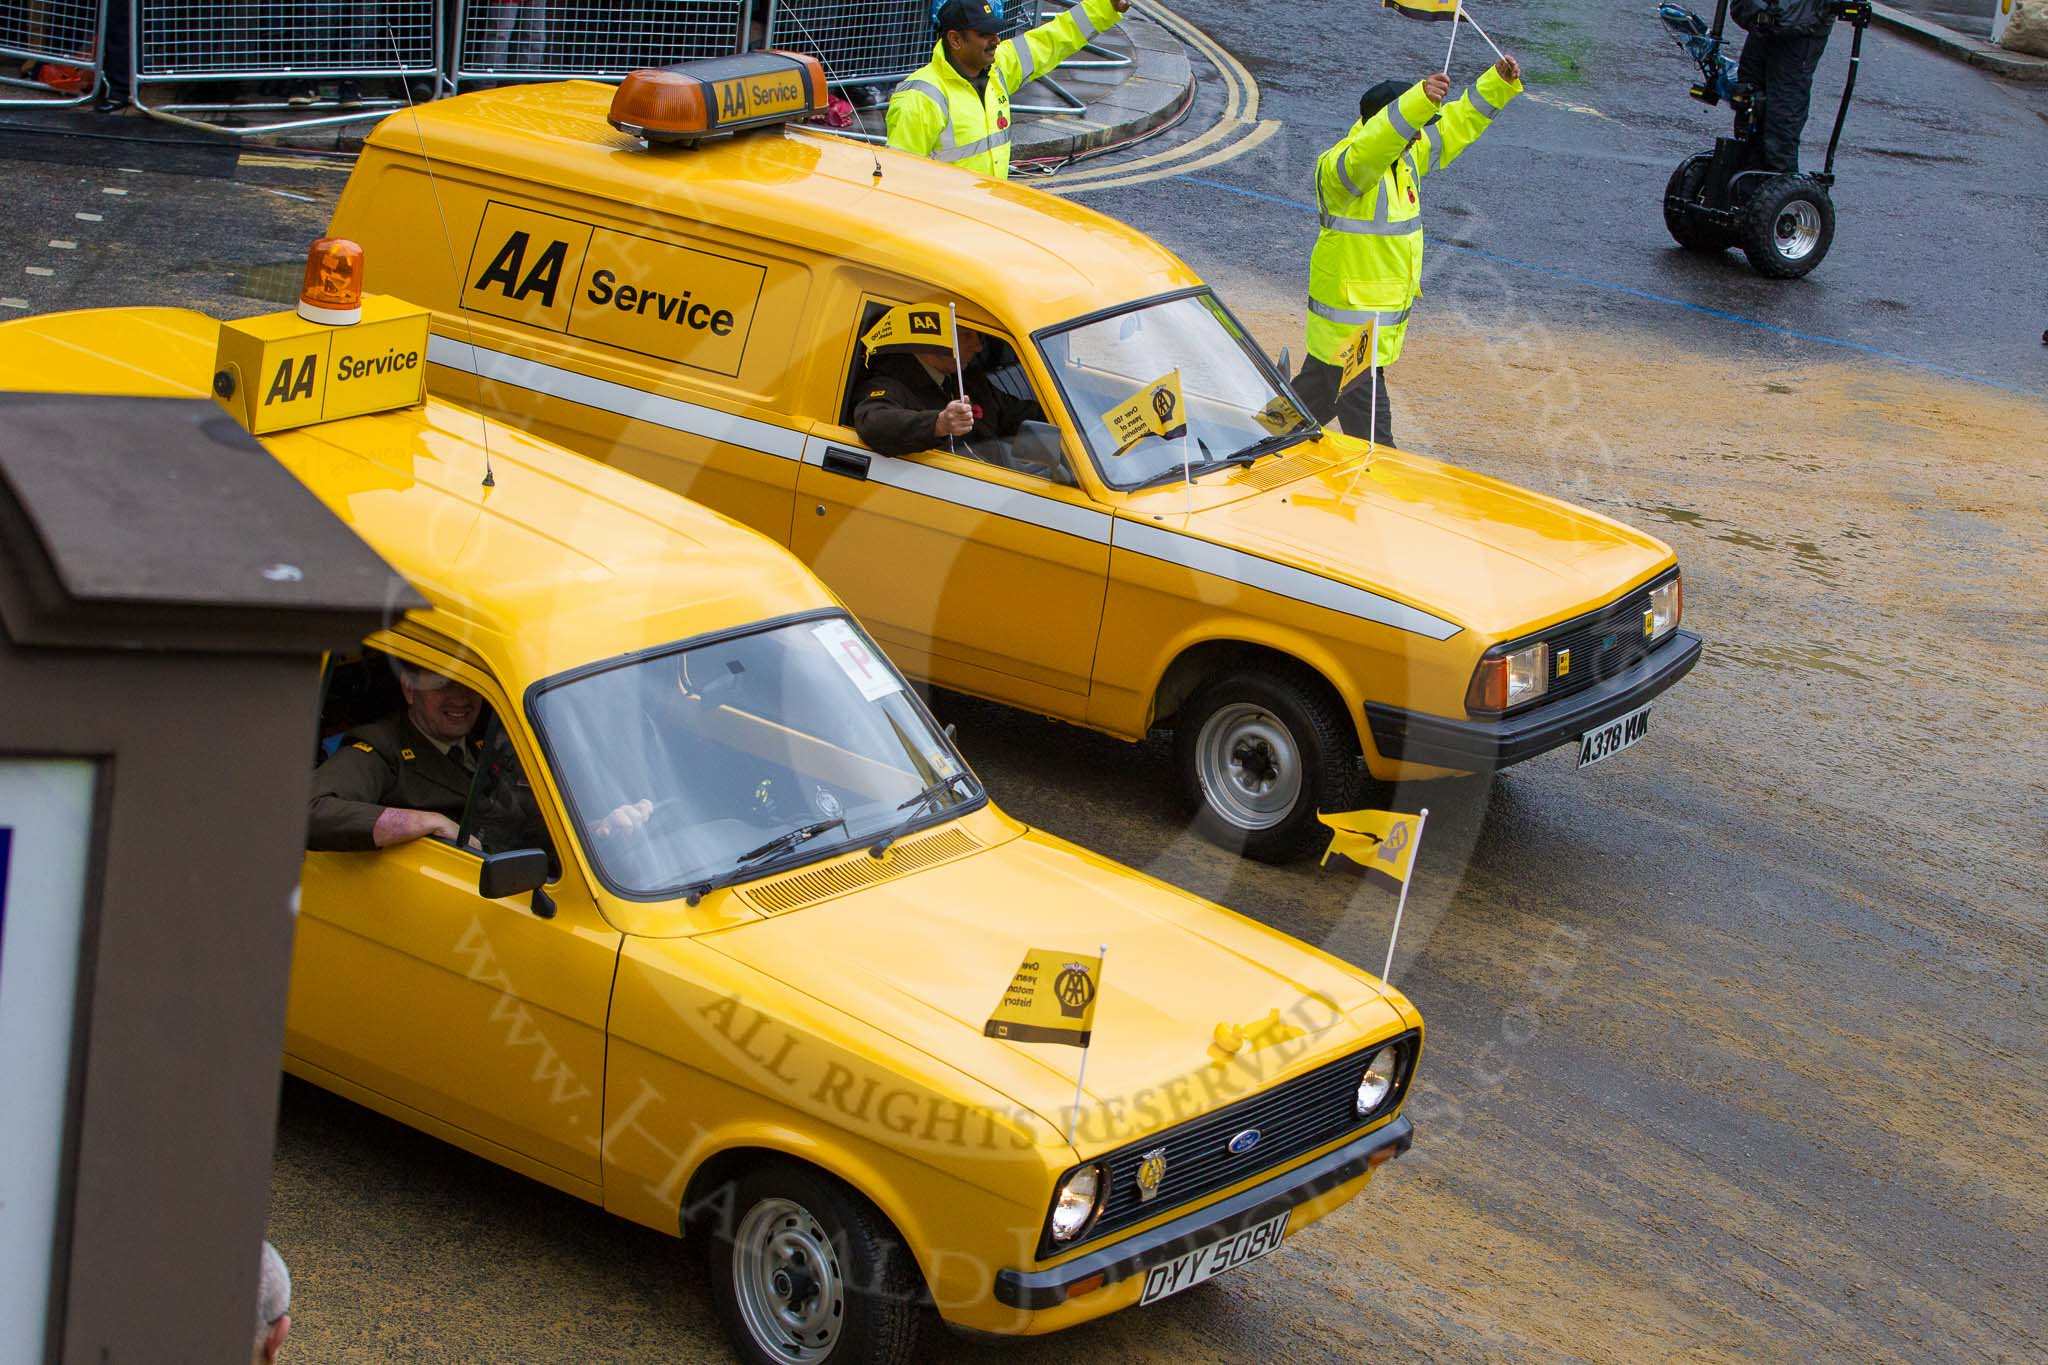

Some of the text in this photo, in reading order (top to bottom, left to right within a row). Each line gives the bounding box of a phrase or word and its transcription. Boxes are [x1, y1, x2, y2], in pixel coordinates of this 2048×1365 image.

[723, 81, 798, 119] AA Service
[474, 230, 734, 336] AA Service
[914, 316, 938, 330] AA
[264, 348, 418, 406] AA Service
[1579, 723, 1622, 766] A378
[1143, 1212, 1290, 1303] DYY 508V
